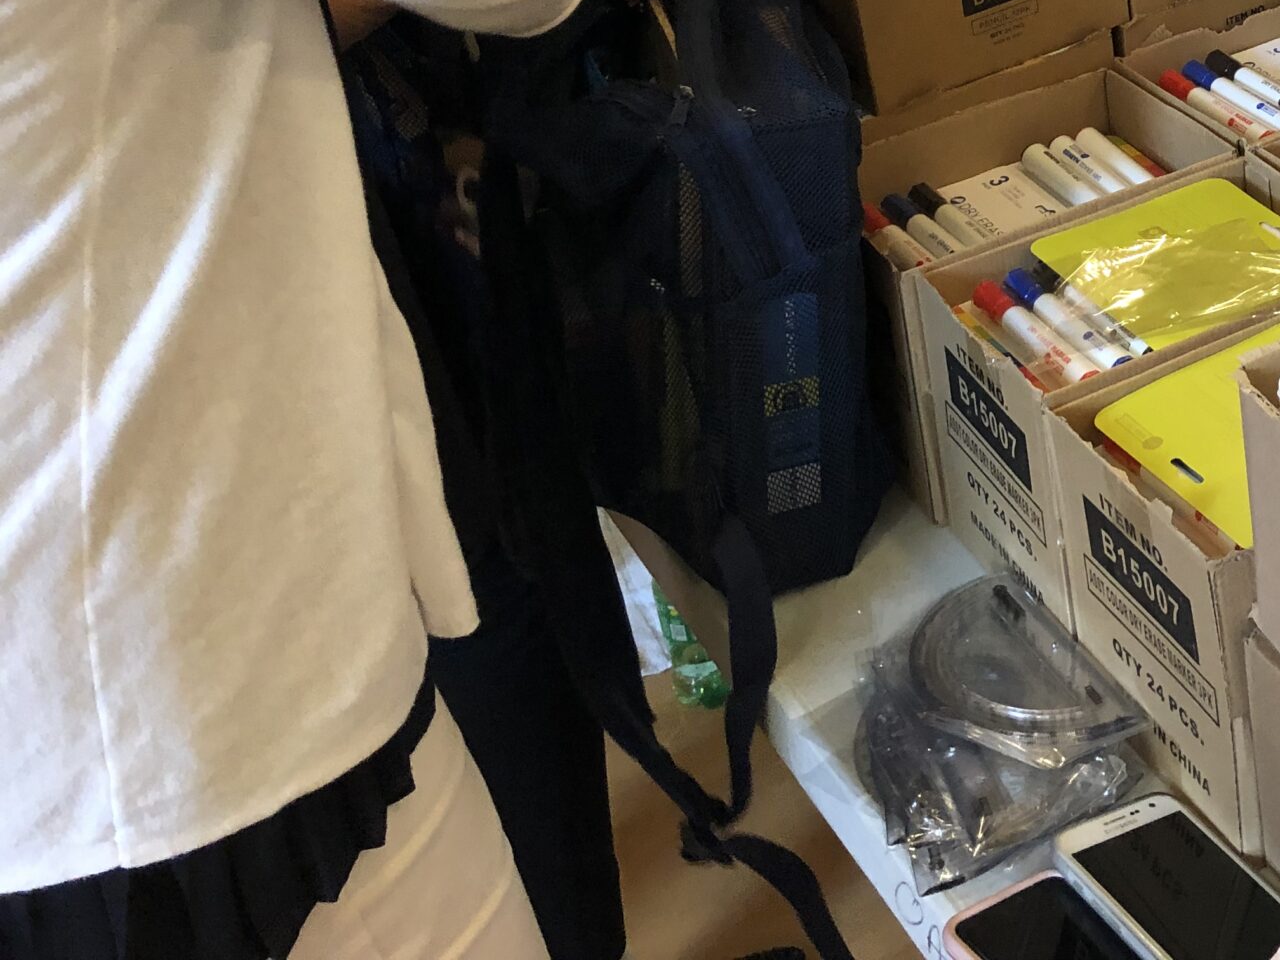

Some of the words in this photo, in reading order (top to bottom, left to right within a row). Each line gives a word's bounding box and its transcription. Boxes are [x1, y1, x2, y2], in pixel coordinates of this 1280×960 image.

[1226, 11, 1248, 26] ITEM
[960, 203, 981, 218] DRY
[980, 217, 1004, 236] ERAS
[989, 175, 1010, 187] 3
[957, 343, 985, 385] ITEM
[986, 376, 1009, 411] NO.
[958, 376, 1017, 459] B15007
[961, 428, 979, 458] COLOR
[979, 447, 990, 470] DRY
[989, 460, 1008, 492] ERASE
[1007, 483, 1030, 517] MARKER
[967, 471, 990, 505] QTY
[992, 500, 1007, 525] 24
[1009, 519, 1038, 561] PCS.
[1099, 492, 1137, 541] ITEM
[1140, 534, 1169, 573] NO.
[970, 510, 998, 550] MADE
[1010, 559, 1046, 606] CHINA
[1101, 528, 1180, 626] B15007
[1106, 587, 1130, 621] COLOR
[1130, 611, 1143, 633] DRY
[1144, 624, 1167, 659] ERASE
[1166, 643, 1198, 691] MARKER
[1112, 638, 1142, 677] QTY
[1146, 672, 1165, 701] 24
[1168, 695, 1205, 746] PCS.
[1153, 720, 1166, 744] IN
[1169, 740, 1211, 796] CHINA
